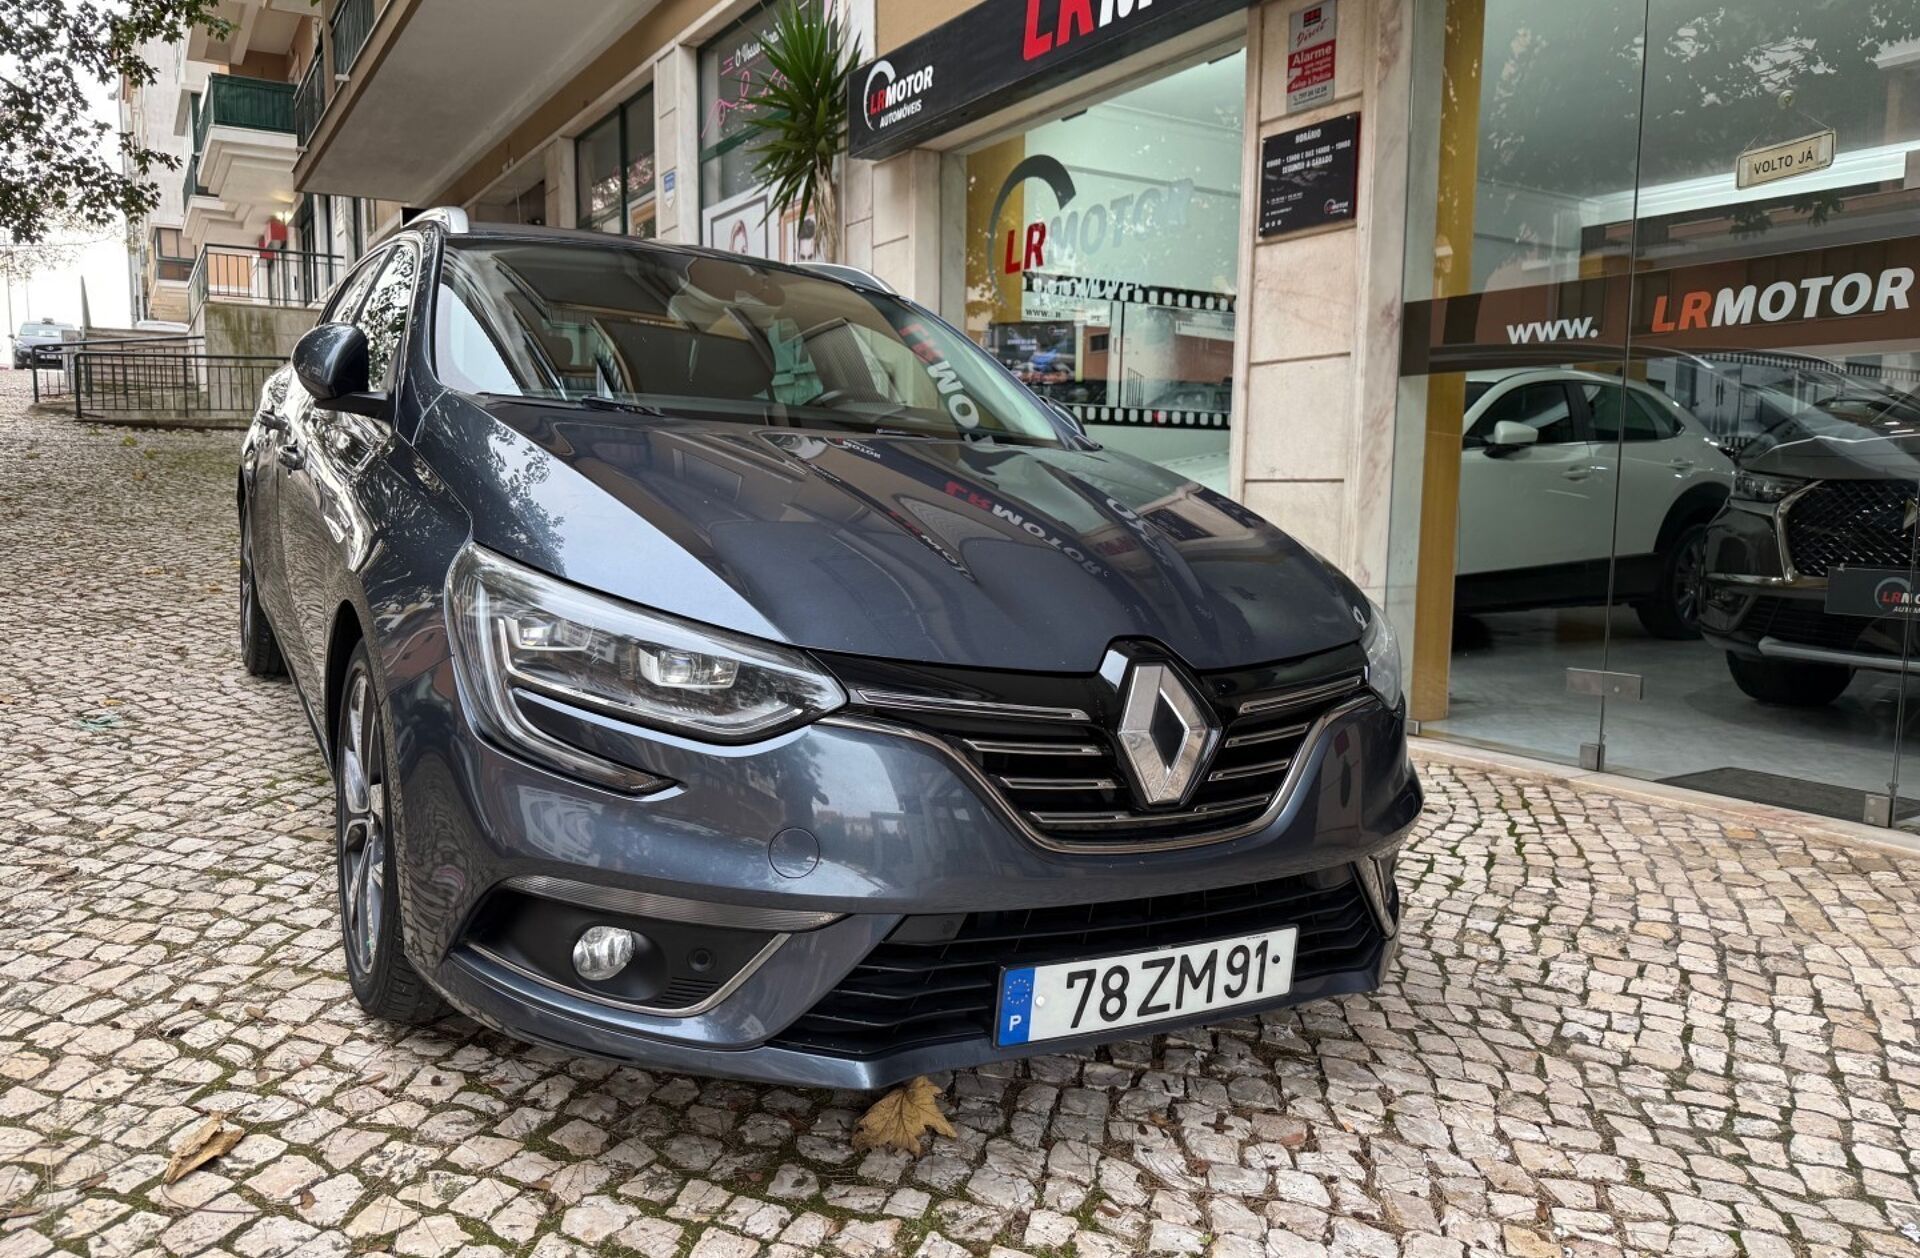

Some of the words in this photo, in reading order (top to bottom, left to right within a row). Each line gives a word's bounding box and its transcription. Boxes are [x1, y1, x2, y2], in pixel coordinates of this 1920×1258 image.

[1292, 45, 1332, 67] Alarme
[870, 65, 933, 115] LRMOTOR
[880, 99, 922, 129] AUTOMÓVEIS
[1754, 155, 1793, 175] VOLTO
[1798, 146, 1813, 164] JÁ
[1506, 316, 1599, 345] www.
[1652, 267, 1915, 333] LRMOTOR
[1009, 1015, 1022, 1031] P
[1066, 940, 1269, 1029] 78ZM91
